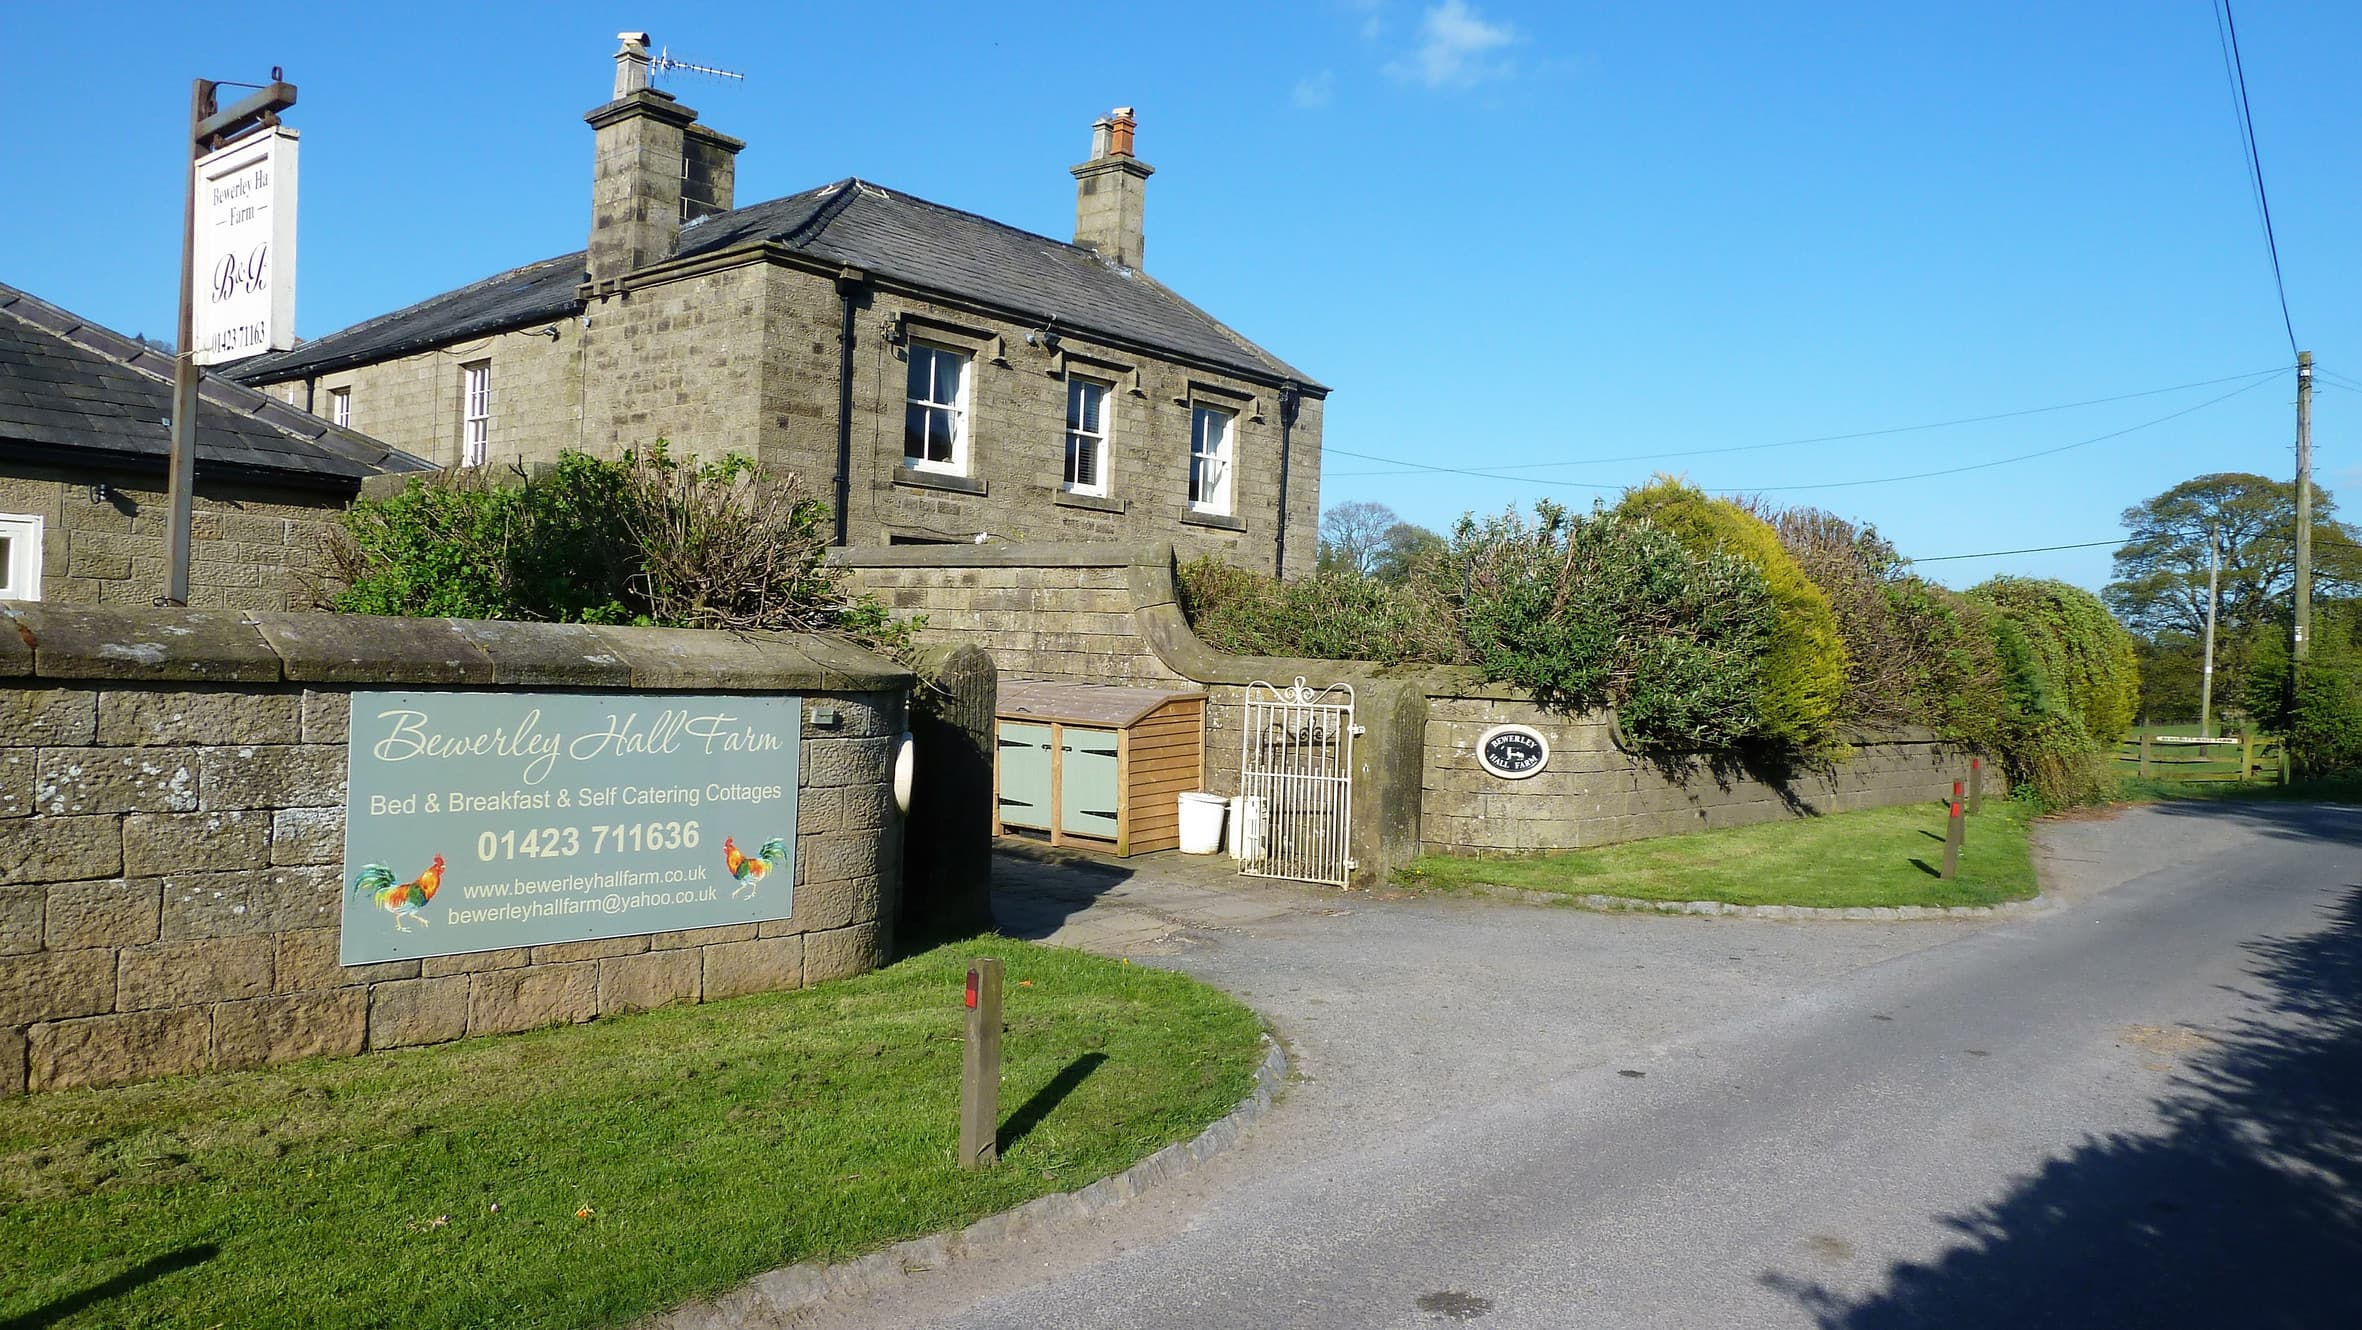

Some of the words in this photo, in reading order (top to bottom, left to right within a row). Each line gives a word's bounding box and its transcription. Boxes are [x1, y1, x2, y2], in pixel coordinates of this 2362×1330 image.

[213, 178, 251, 206] Bewerley
[230, 206, 254, 226] Farm
[211, 328, 236, 354] 01423
[373, 709, 561, 785] Bewerley
[569, 710, 688, 760] Hall
[684, 713, 783, 755] Farm
[1490, 735, 1537, 749] BEWERLEY
[1489, 753, 1510, 769] HALL
[1514, 755, 1538, 769] FARM
[370, 793, 417, 816] Bed
[424, 793, 441, 814] &
[449, 790, 551, 812] Breakfast
[557, 788, 571, 808] &
[578, 786, 617, 808] Self
[622, 785, 700, 807] Catering
[705, 783, 782, 804] Cottages
[477, 826, 580, 862] 01423
[591, 820, 700, 854] 711636
[463, 865, 707, 899] www.bewerleyhallfarm.co.uk
[447, 886, 718, 925] bewerleyhallfarm@yahoo.co.uk
